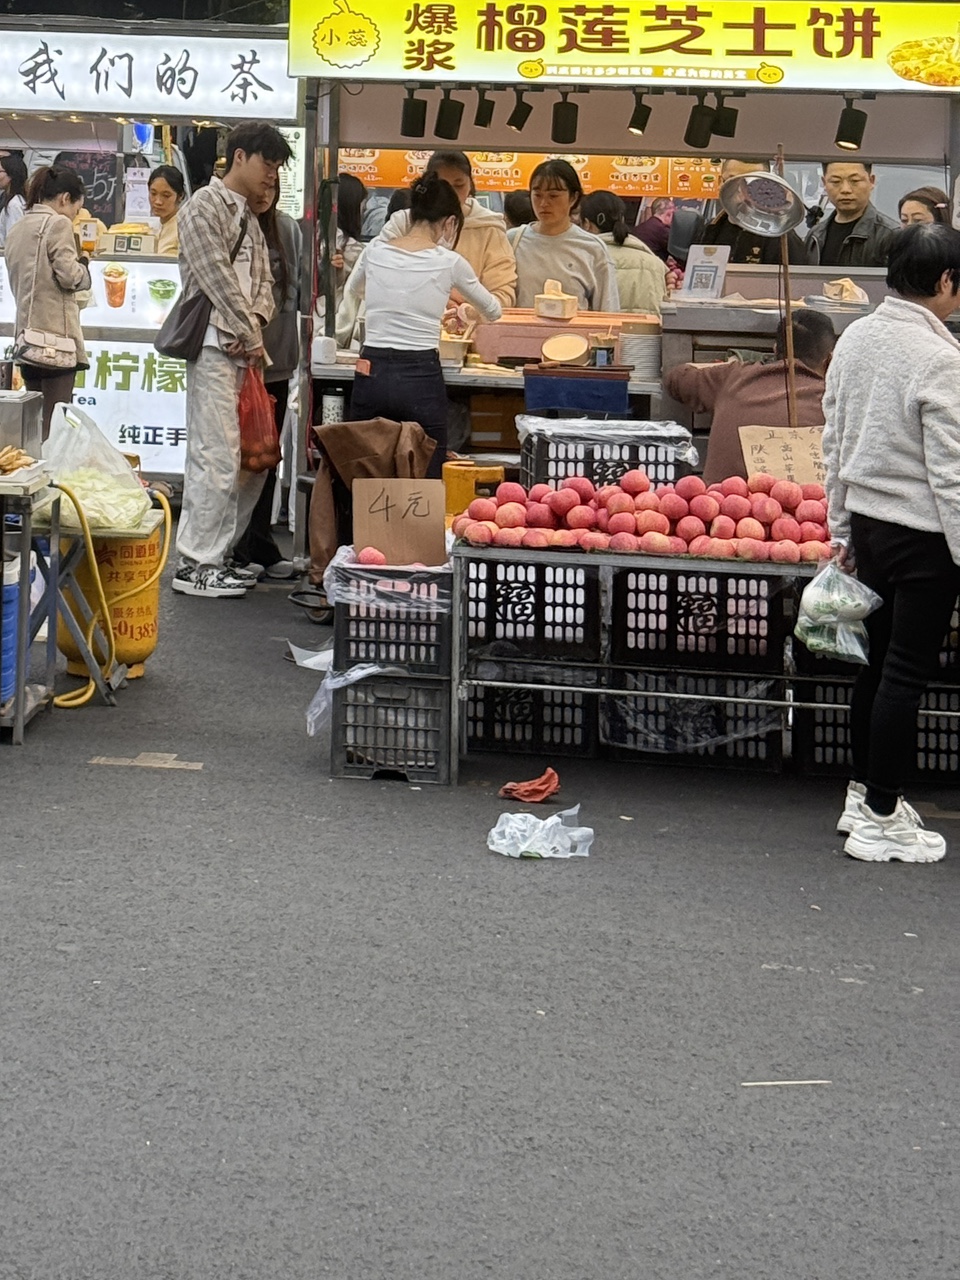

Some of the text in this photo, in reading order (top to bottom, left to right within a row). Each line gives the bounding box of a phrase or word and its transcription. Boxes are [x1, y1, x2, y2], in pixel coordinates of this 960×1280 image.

[320, 27, 367, 49] 小蕊
[403, 1, 881, 72] 爆浆 榴莲芝士饼
[18, 39, 274, 104] 我们的茶
[369, 486, 430, 522] 4元
